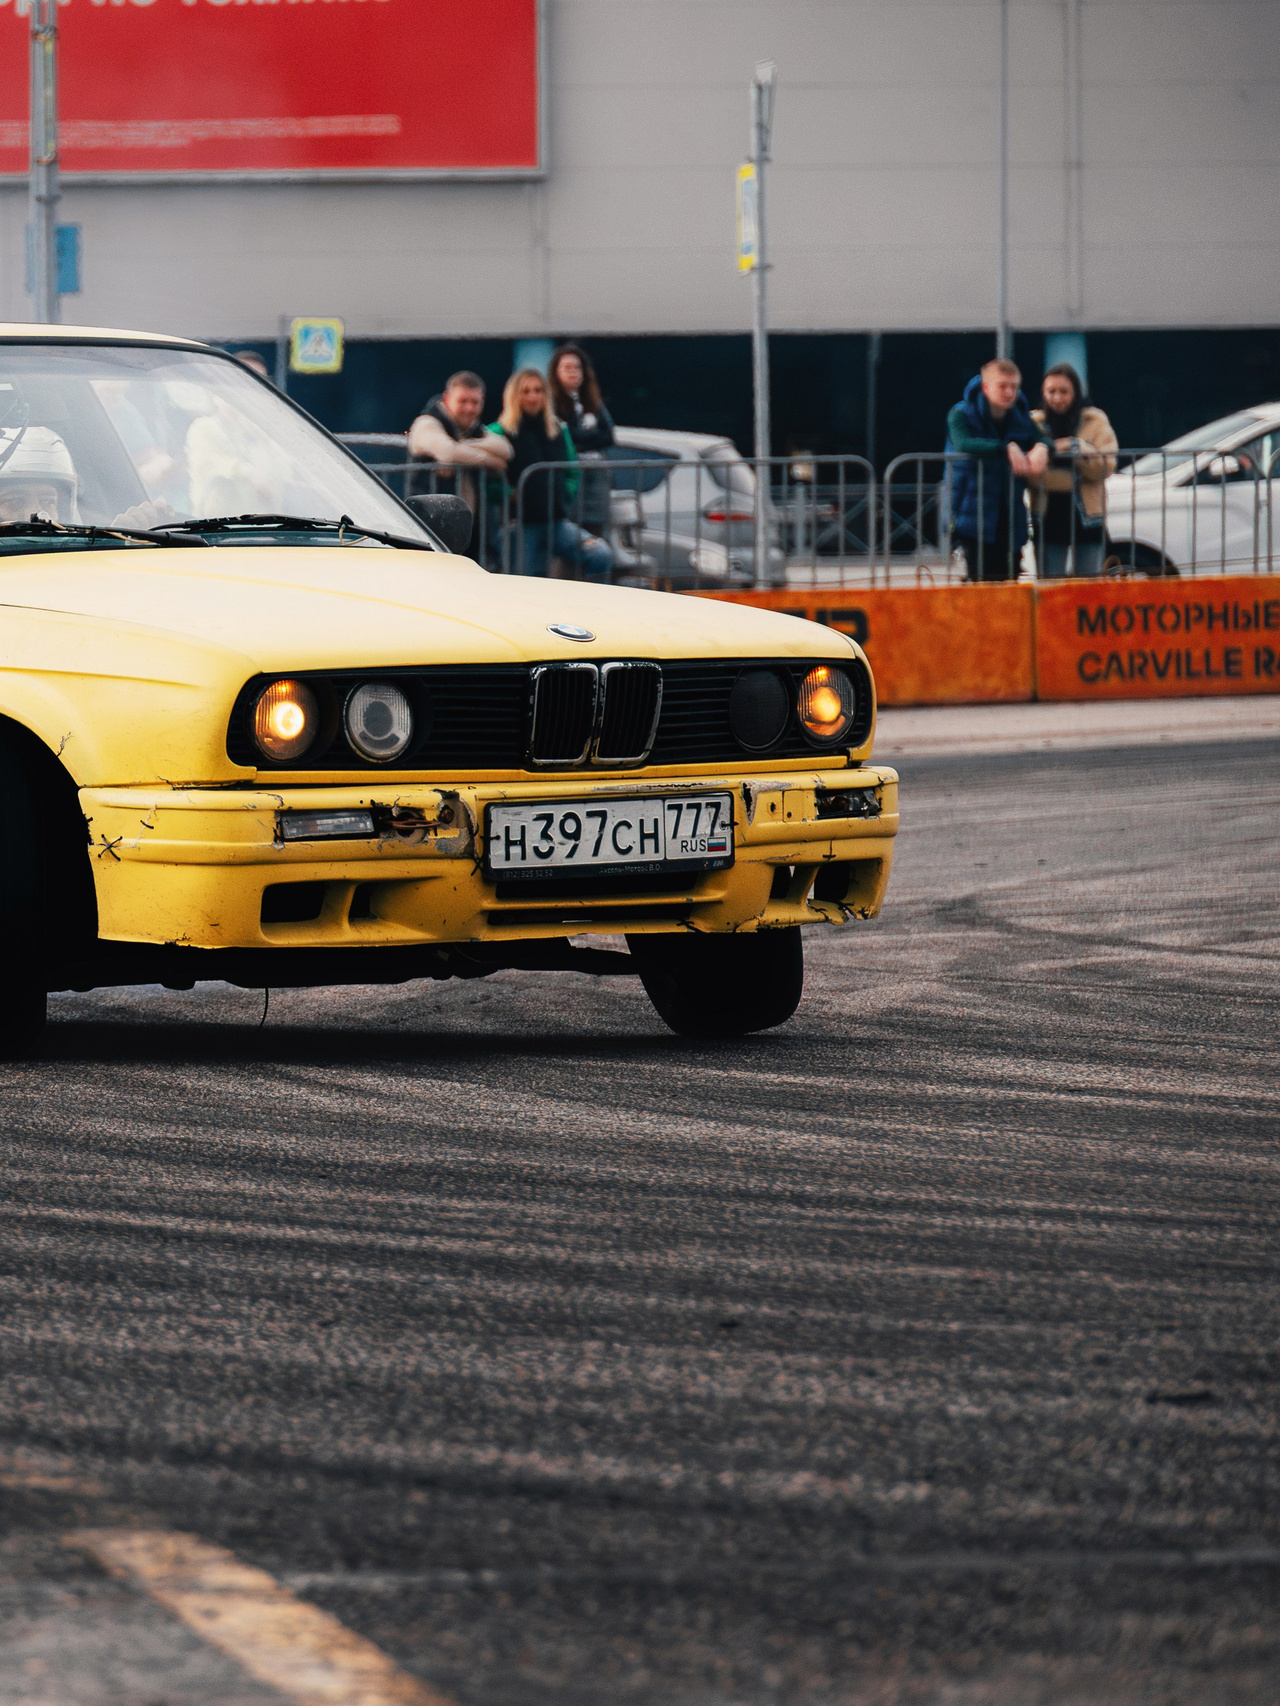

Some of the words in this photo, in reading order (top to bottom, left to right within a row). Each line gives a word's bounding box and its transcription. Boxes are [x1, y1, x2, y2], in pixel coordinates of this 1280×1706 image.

[1076, 601, 1280, 636] МОТОРНЫЕ
[1076, 647, 1243, 685] CARVILLE
[666, 802, 722, 840] 777
[680, 839, 707, 852] RUS
